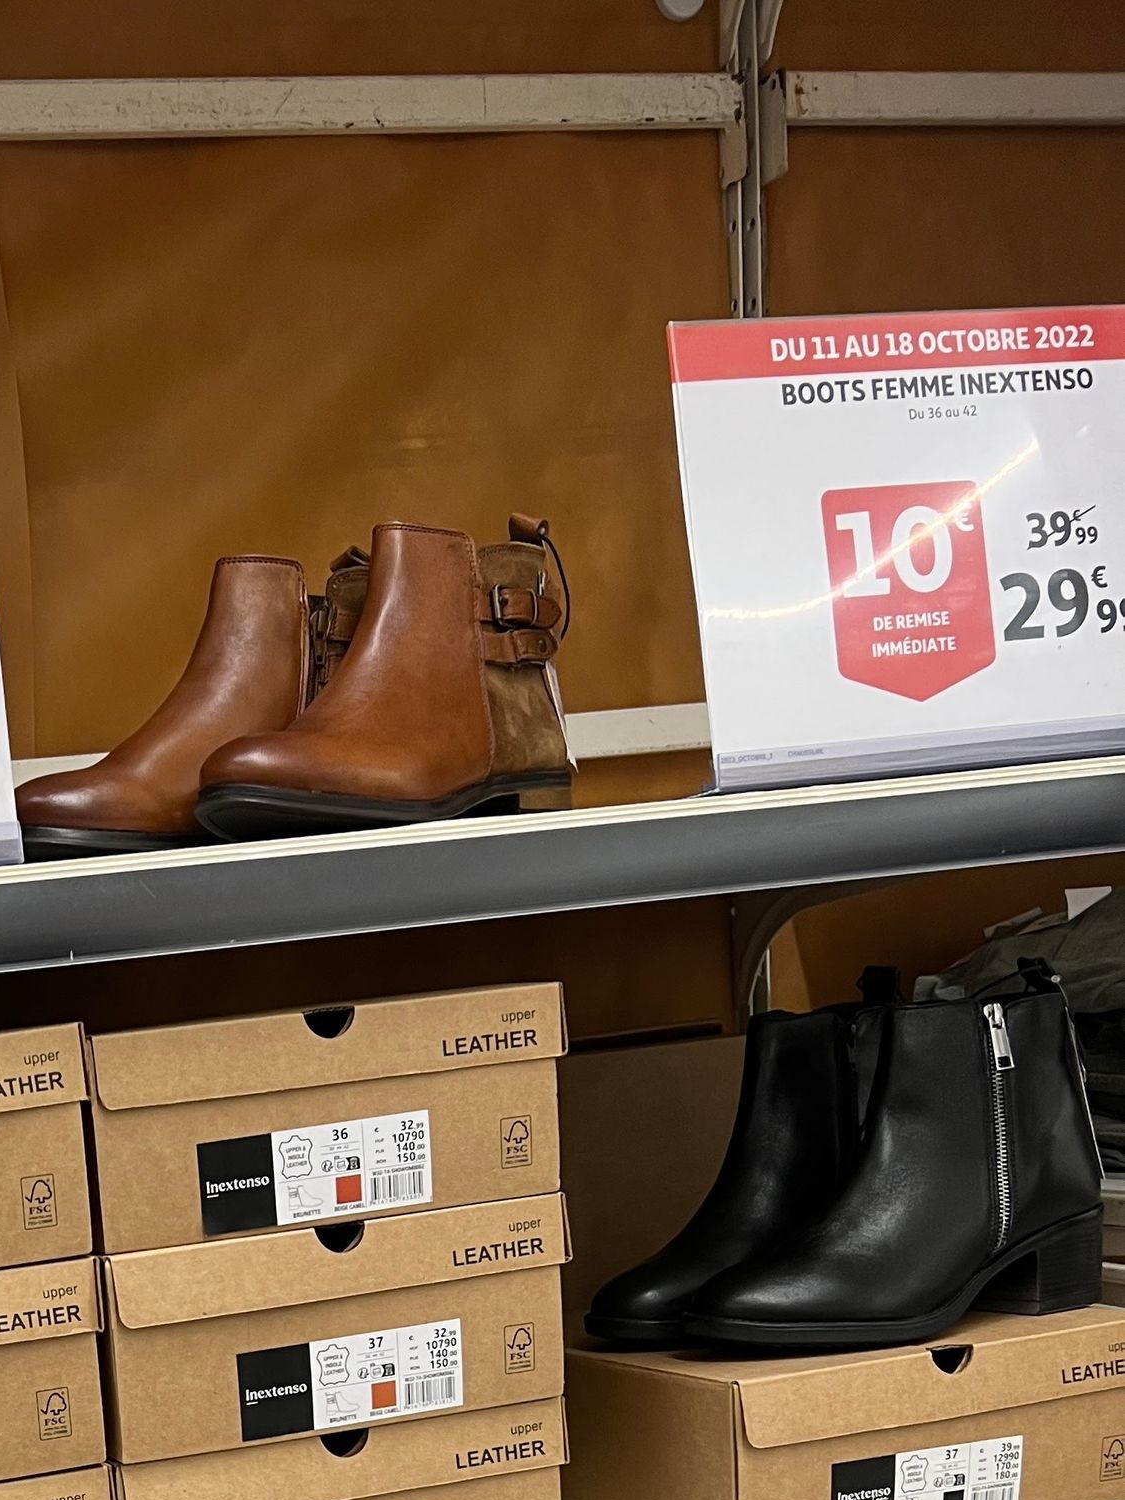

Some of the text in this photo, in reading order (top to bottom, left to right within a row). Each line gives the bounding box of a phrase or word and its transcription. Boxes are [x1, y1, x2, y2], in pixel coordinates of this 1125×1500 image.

[771, 325, 1094, 361] DU 11 AU 18 OCTOBRE 2022
[782, 368, 1092, 405] BOOTS FEMME INEXTENSO
[909, 405, 976, 419] Du 36 au 42
[874, 611, 949, 631] DE REMISE
[872, 637, 956, 657] IMMÉDIATE
[502, 1010, 535, 1024] upper
[443, 1030, 537, 1056] LEATHER
[24, 1051, 59, 1066] upper
[333, 1128, 348, 1141] 36
[392, 1129, 424, 1143] 10790
[506, 1145, 528, 1154] FSC
[206, 1176, 269, 1193] Inextenso
[28, 1204, 51, 1215] FSC
[453, 1238, 544, 1266] LEATHER
[369, 1337, 383, 1349] 37
[1062, 1359, 1125, 1384] LEATHE
[246, 1384, 307, 1404] Inextenso
[511, 1422, 542, 1436] upper
[456, 1441, 547, 1471] LEATHER
[946, 1449, 958, 1460] 37
[993, 1451, 1019, 1462] 12990
